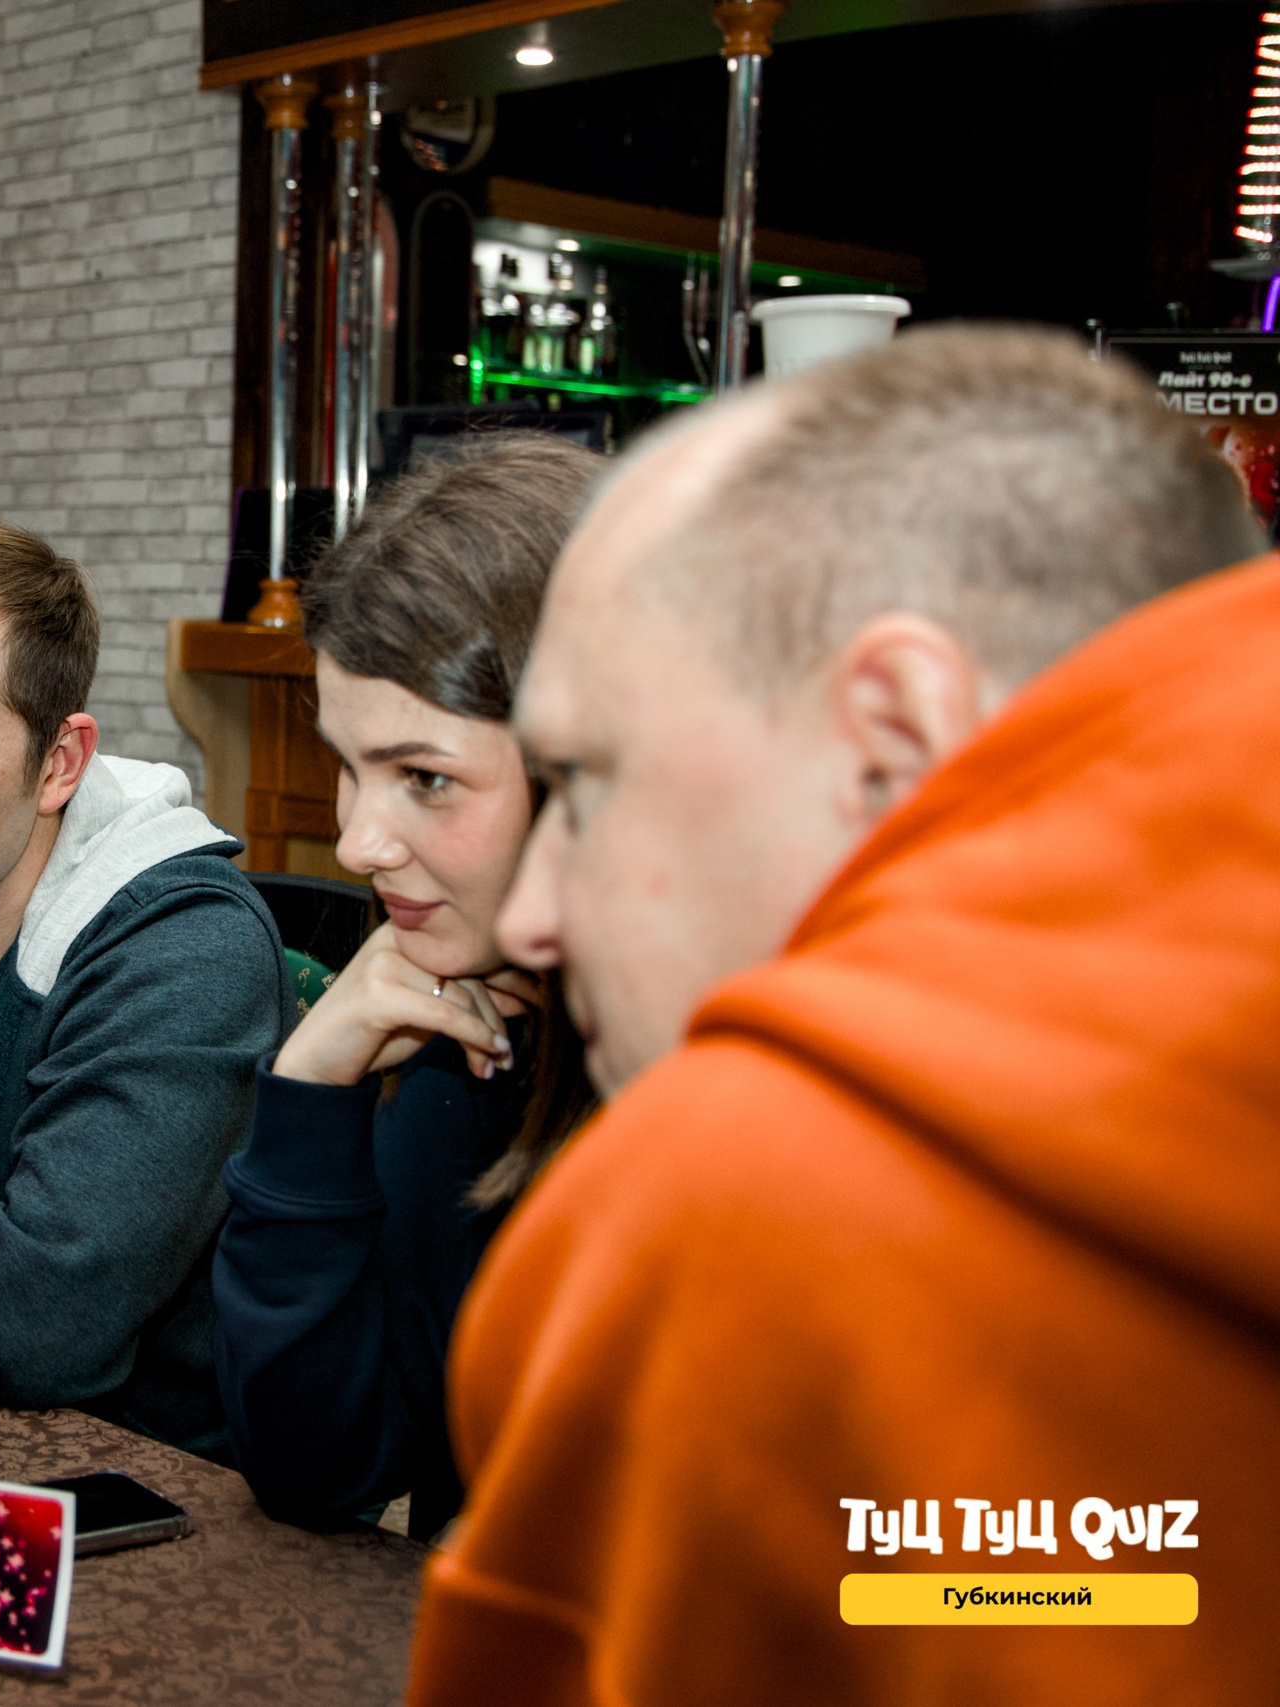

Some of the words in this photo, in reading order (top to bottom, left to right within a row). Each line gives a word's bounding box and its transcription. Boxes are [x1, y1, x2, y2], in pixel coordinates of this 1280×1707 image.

[1158, 371, 1206, 388] Лайт
[1208, 371, 1252, 388] 90-е
[1156, 391, 1278, 416] МЕСТО
